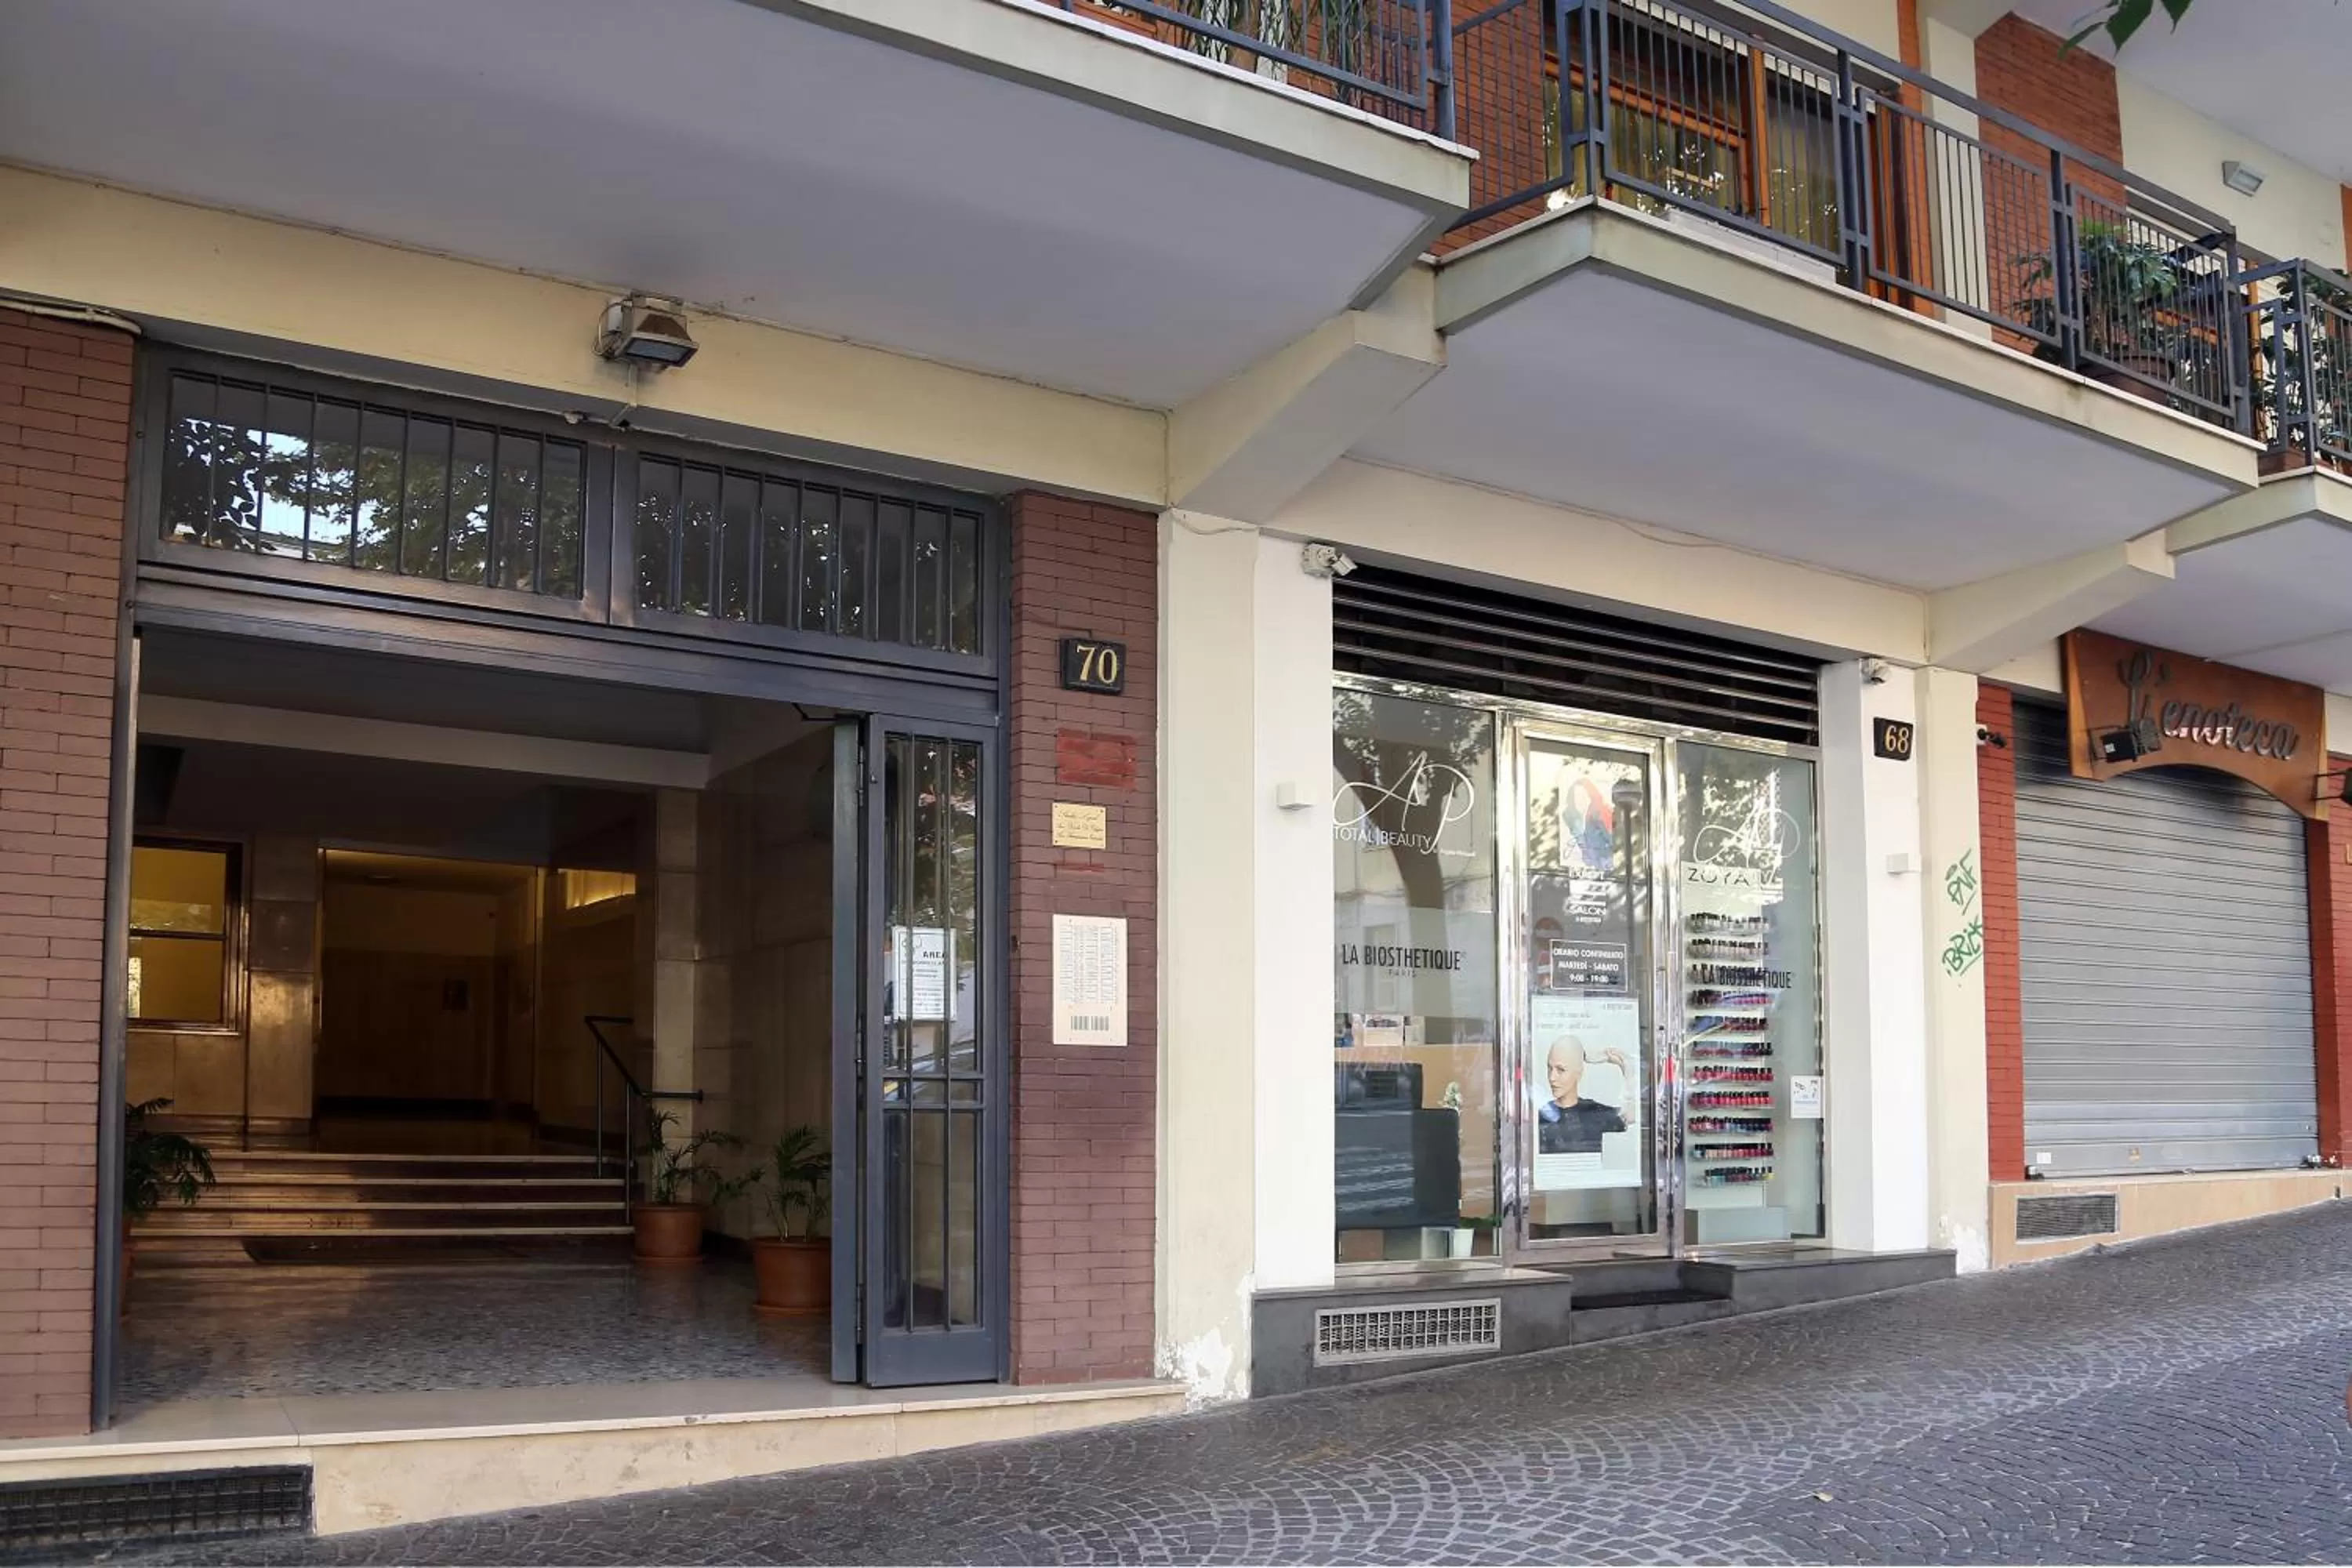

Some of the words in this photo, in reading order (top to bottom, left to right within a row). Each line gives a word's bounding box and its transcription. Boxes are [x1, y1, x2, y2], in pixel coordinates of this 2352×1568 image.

[1076, 645, 1118, 684] 70
[1885, 725, 1909, 753] 68
[1688, 868, 1750, 886] ZOYA
[1341, 943, 1359, 965] LA
[1363, 945, 1461, 971] BIOSTHETIQUE
